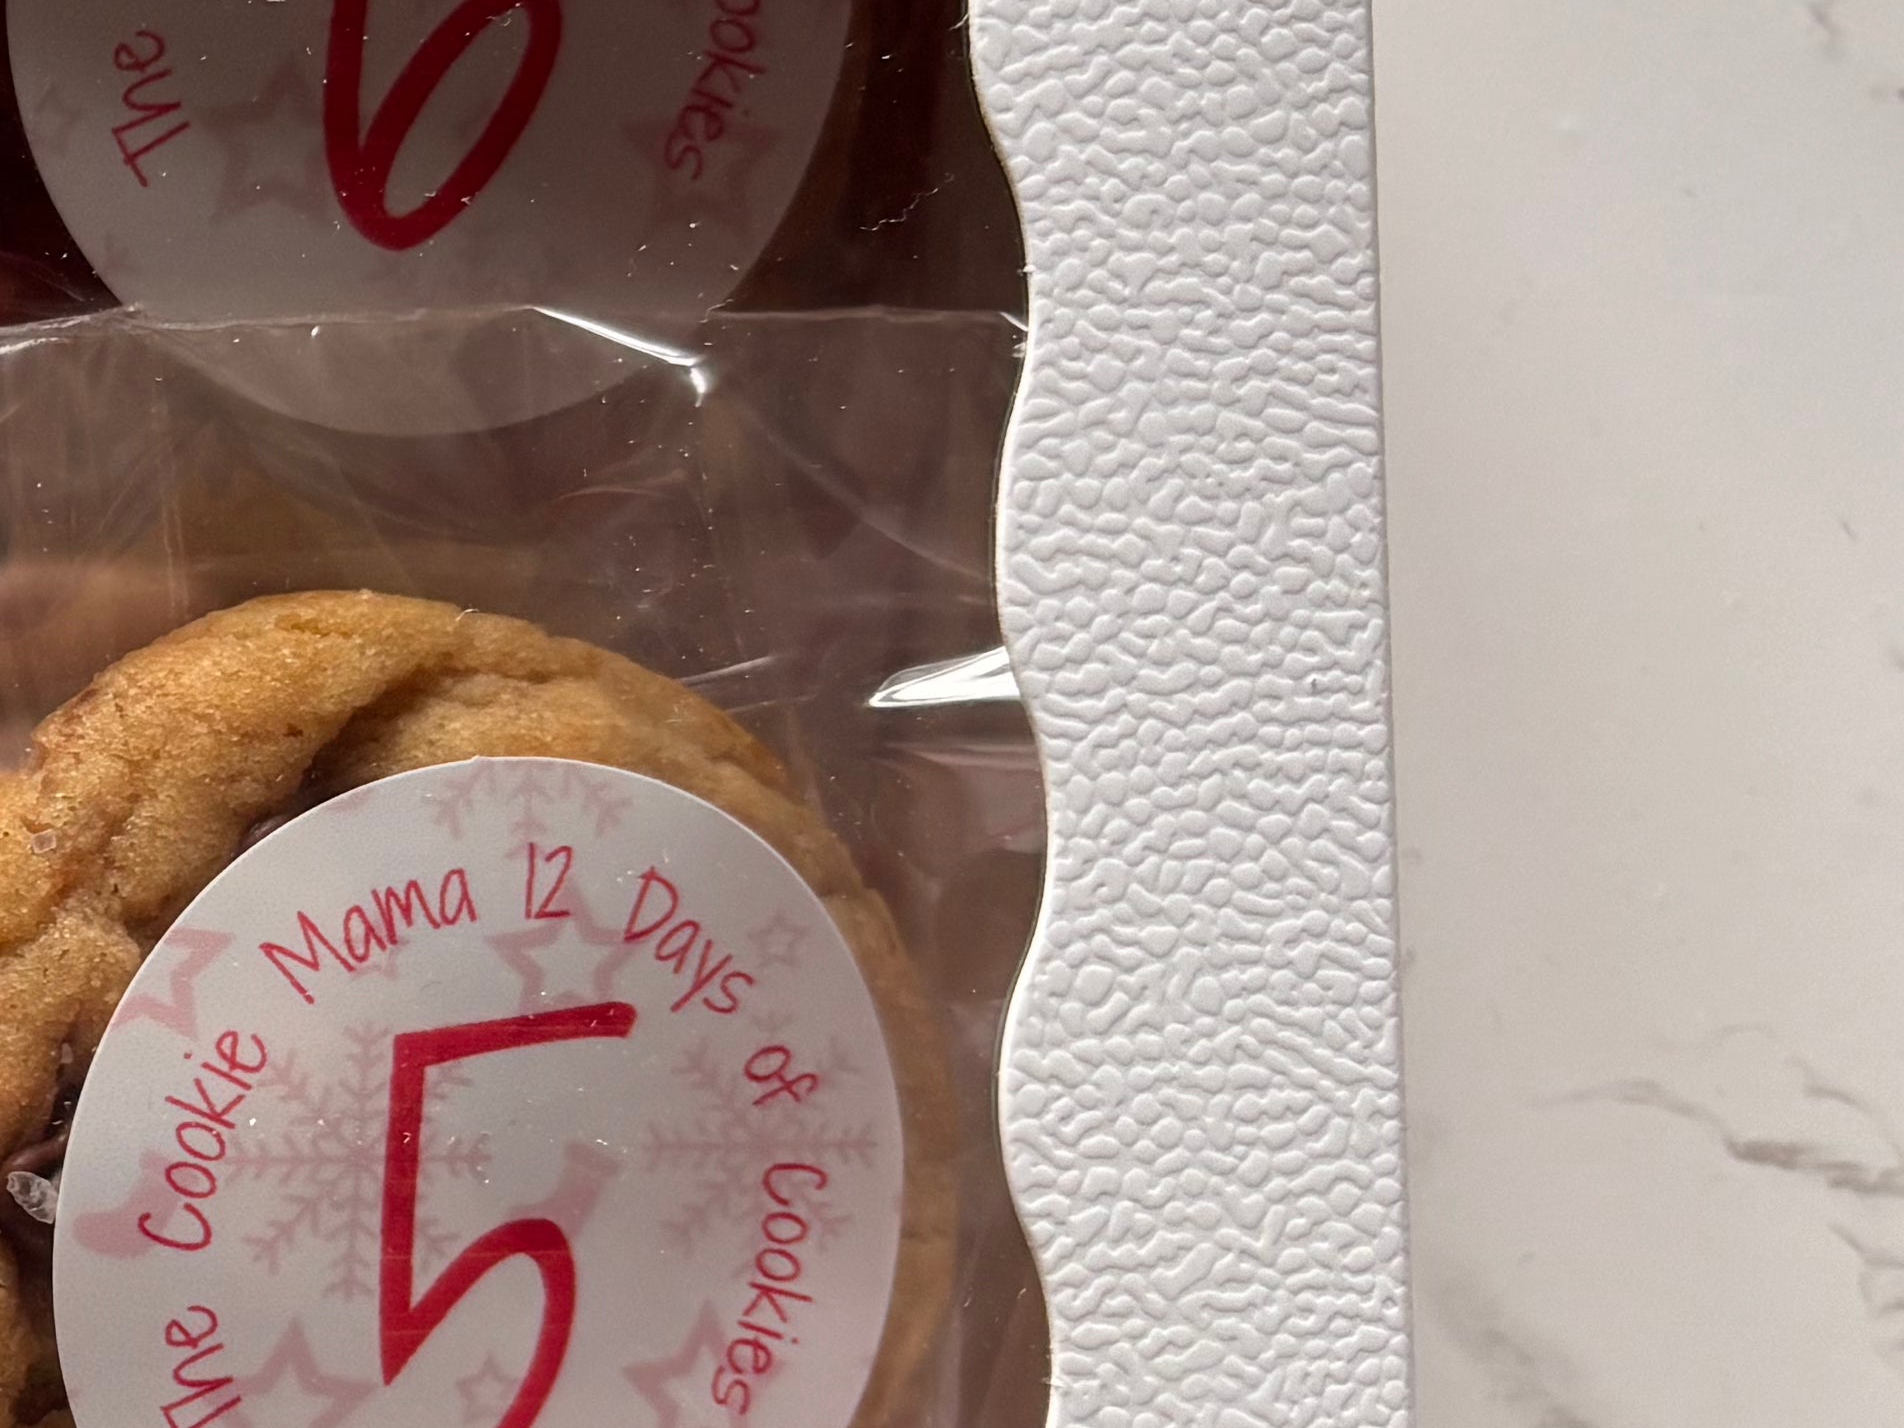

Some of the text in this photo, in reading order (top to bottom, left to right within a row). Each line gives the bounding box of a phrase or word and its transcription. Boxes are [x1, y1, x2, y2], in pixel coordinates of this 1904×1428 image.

[112, 30, 191, 187] The
[258, 867, 477, 1004] Mama
[523, 842, 574, 921] 12
[623, 865, 759, 1016] Days
[137, 1028, 269, 1253] Cookie
[742, 1042, 820, 1108] of
[711, 1162, 829, 1419] Cookies
